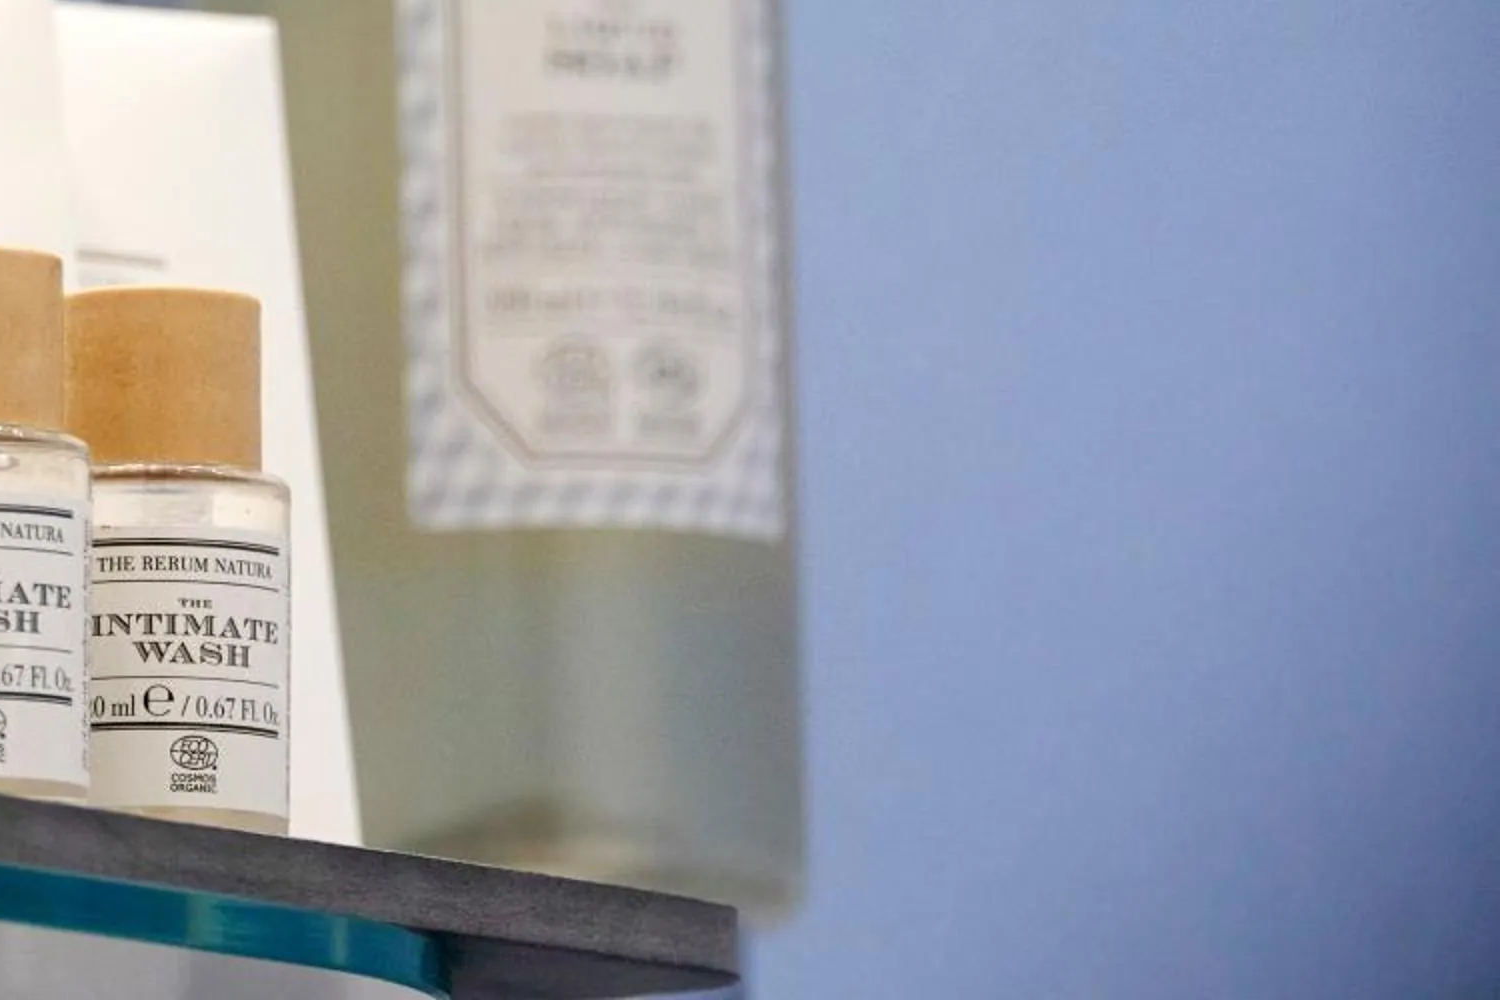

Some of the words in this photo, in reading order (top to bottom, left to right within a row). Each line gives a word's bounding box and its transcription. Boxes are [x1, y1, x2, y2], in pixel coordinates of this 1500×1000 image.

[0, 523, 64, 543] NATURA
[97, 556, 135, 573] THE
[142, 555, 209, 573] RERUM
[215, 558, 273, 579] NATURA
[178, 598, 213, 609] THE
[91, 613, 279, 645] INTIMATE
[132, 641, 251, 668] WASH
[90, 695, 105, 719] 0
[111, 694, 135, 717] ml
[195, 695, 236, 719] 0.67
[171, 773, 217, 784] COSMOS
